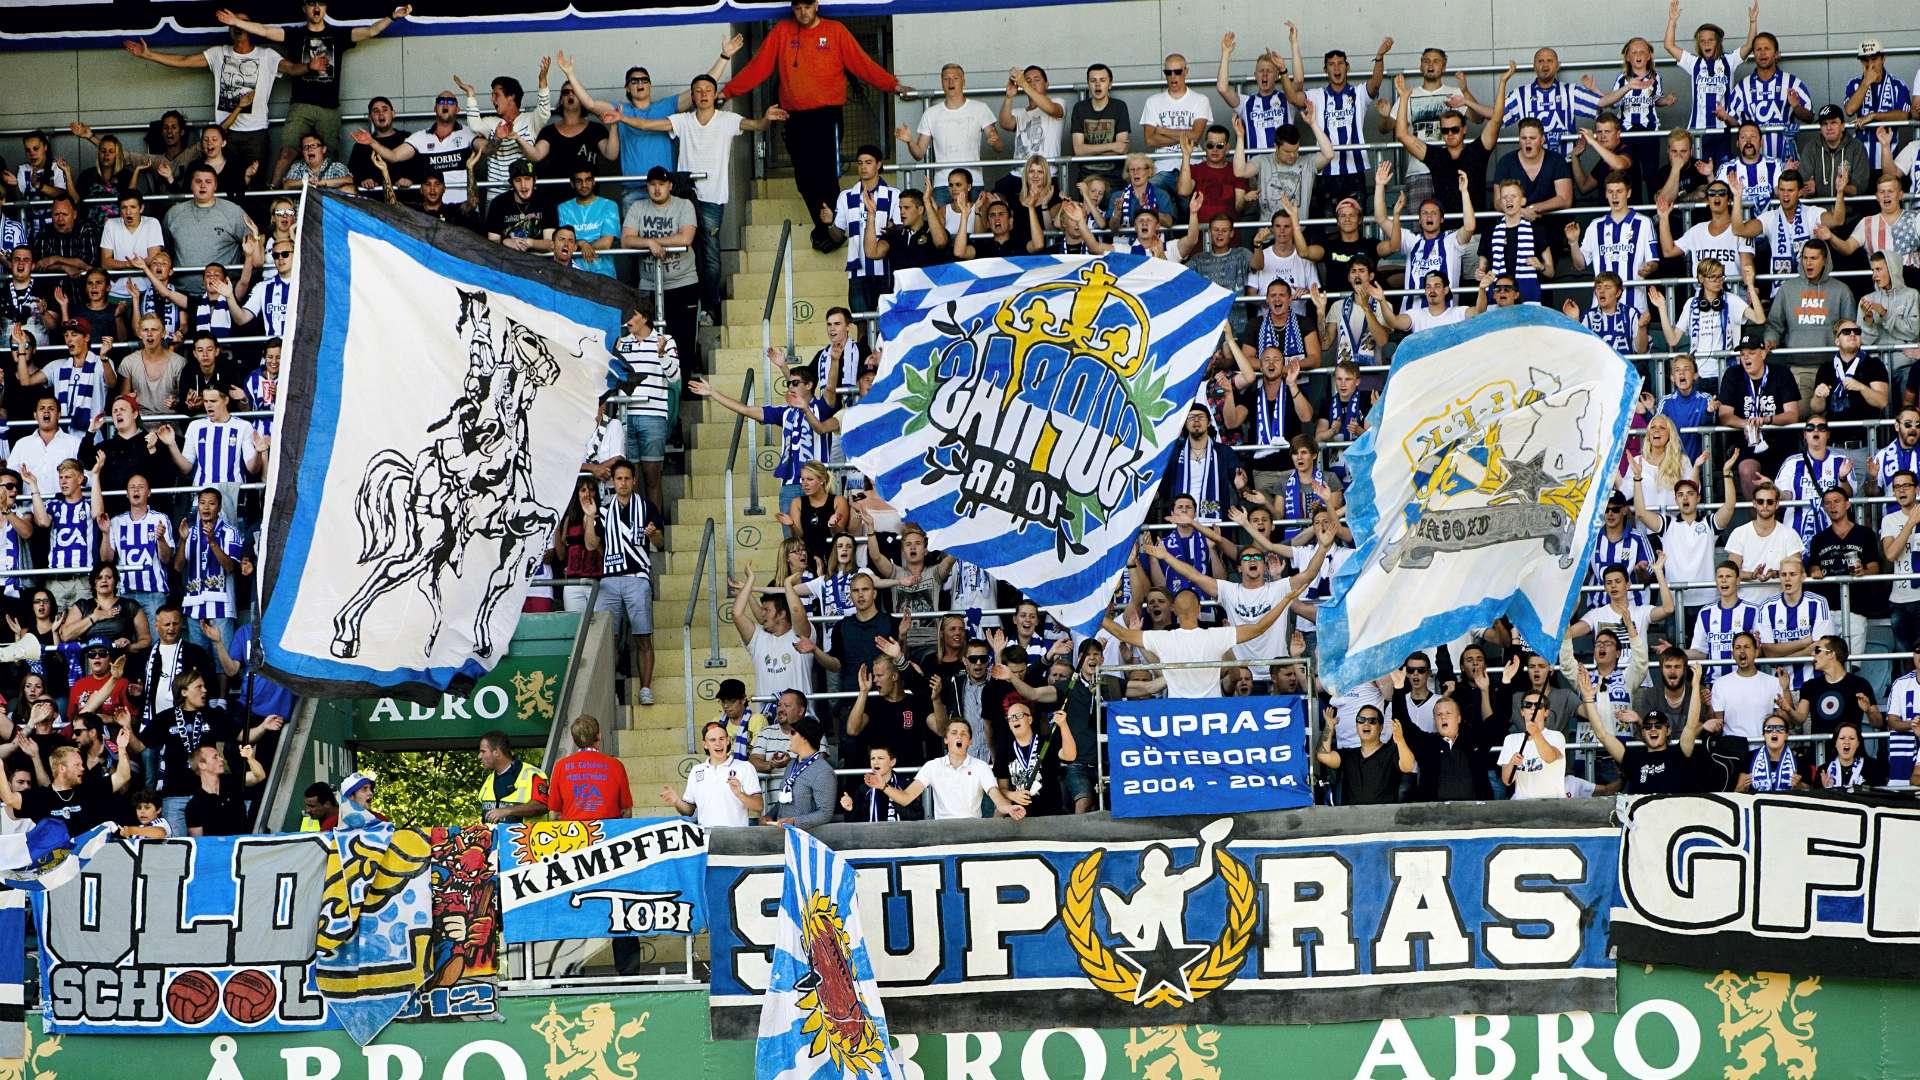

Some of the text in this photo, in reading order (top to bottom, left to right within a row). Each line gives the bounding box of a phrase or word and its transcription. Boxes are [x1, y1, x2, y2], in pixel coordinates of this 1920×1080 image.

[429, 153, 462, 164] MORRIS
[1600, 243, 1634, 255] Prioritet
[1801, 298, 1825, 308] FAST
[794, 304, 810, 318] 10
[1798, 315, 1826, 325] FAST?
[765, 454, 774, 468] 8
[1801, 478, 1837, 488] Pritet
[744, 530, 754, 544] 7
[121, 549, 153, 566] ICA
[1708, 632, 1734, 641] Priorit
[1774, 627, 1813, 638] Prioritet
[1712, 642, 1734, 650] Finan
[705, 683, 713, 697] 5
[903, 711, 913, 728] B
[1116, 707, 1291, 737] SUPRAS
[1121, 745, 1291, 767] GÖTEBORG
[573, 783, 602, 799] ICA
[1124, 777, 1195, 795] 2004
[1230, 775, 1297, 788] 2014
[509, 824, 705, 900] KÄMPFEN
[47, 837, 337, 966] OLD
[570, 890, 694, 934] TOBI
[50, 964, 327, 1024] SCHOOL
